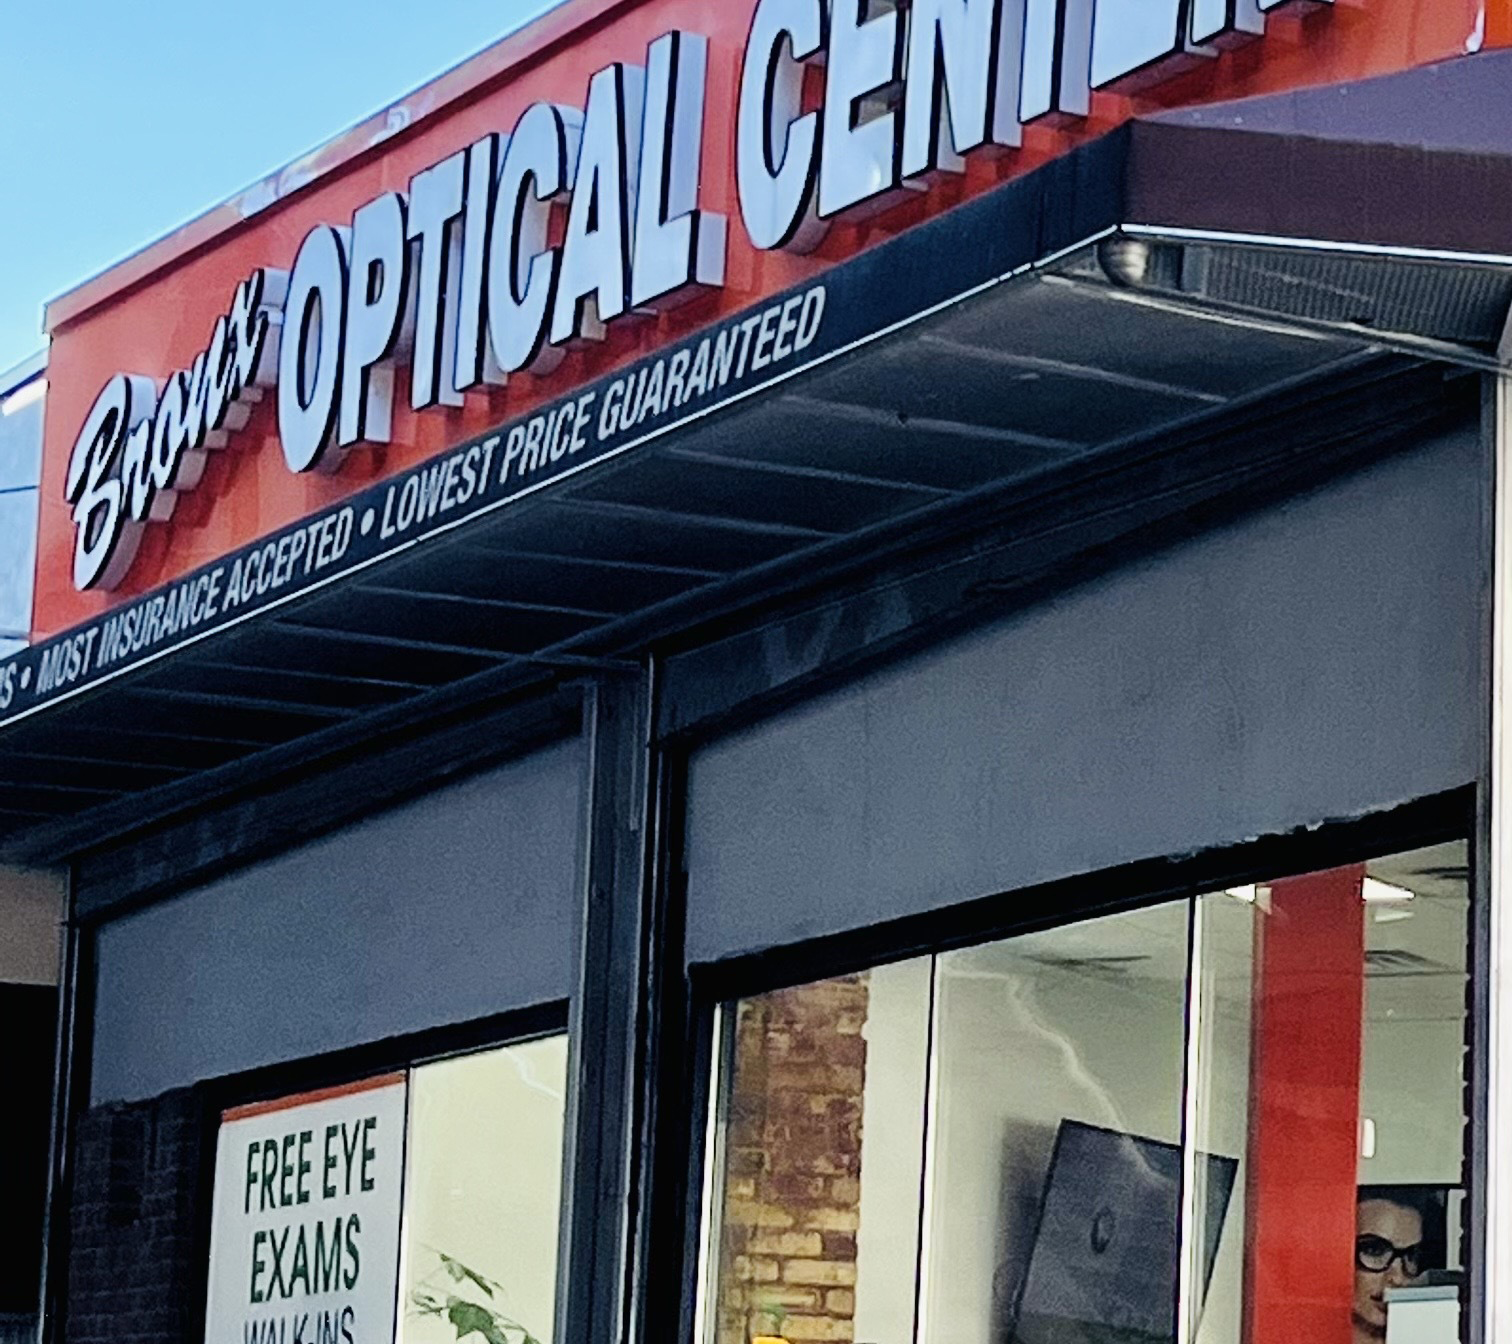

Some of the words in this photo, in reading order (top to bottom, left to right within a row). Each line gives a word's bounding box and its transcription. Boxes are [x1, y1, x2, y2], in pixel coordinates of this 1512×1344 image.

[65, 267, 270, 592] Bronx
[277, 29, 706, 474] OPTICAL
[36, 626, 99, 697] MOST
[97, 568, 226, 668] INSURANCE
[222, 506, 354, 614] ACCEPTED
[379, 435, 501, 540] LOWEST
[499, 391, 597, 484] PRICE
[597, 285, 828, 442] GUARANTEED
[244, 1129, 313, 1214] FREE
[322, 1116, 377, 1199] EYE
[249, 1213, 361, 1304] EXAMS
